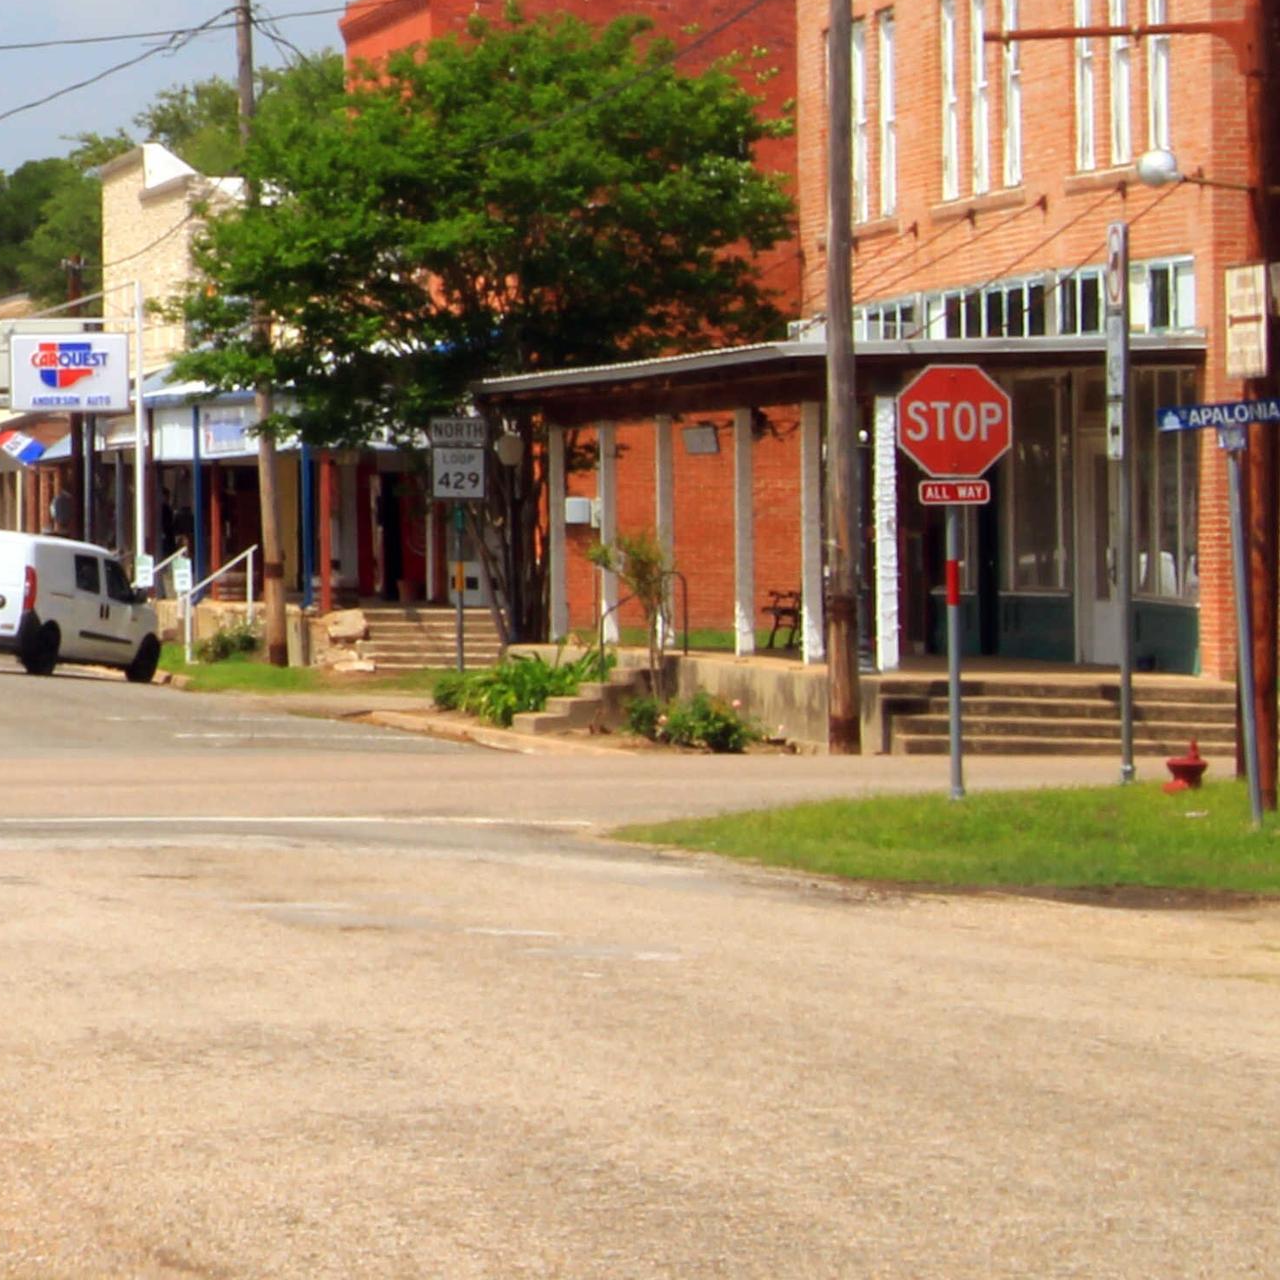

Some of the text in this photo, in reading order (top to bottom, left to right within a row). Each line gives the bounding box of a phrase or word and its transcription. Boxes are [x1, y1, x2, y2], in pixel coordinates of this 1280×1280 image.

[31, 352, 108, 368] CARQUEST
[32, 395, 111, 406] ANDERSON AUTO
[906, 401, 1002, 442] STOP
[434, 422, 482, 438] NORTH
[442, 453, 475, 465] LOOP
[438, 471, 480, 490] 429
[925, 485, 984, 500] ALL WAY
